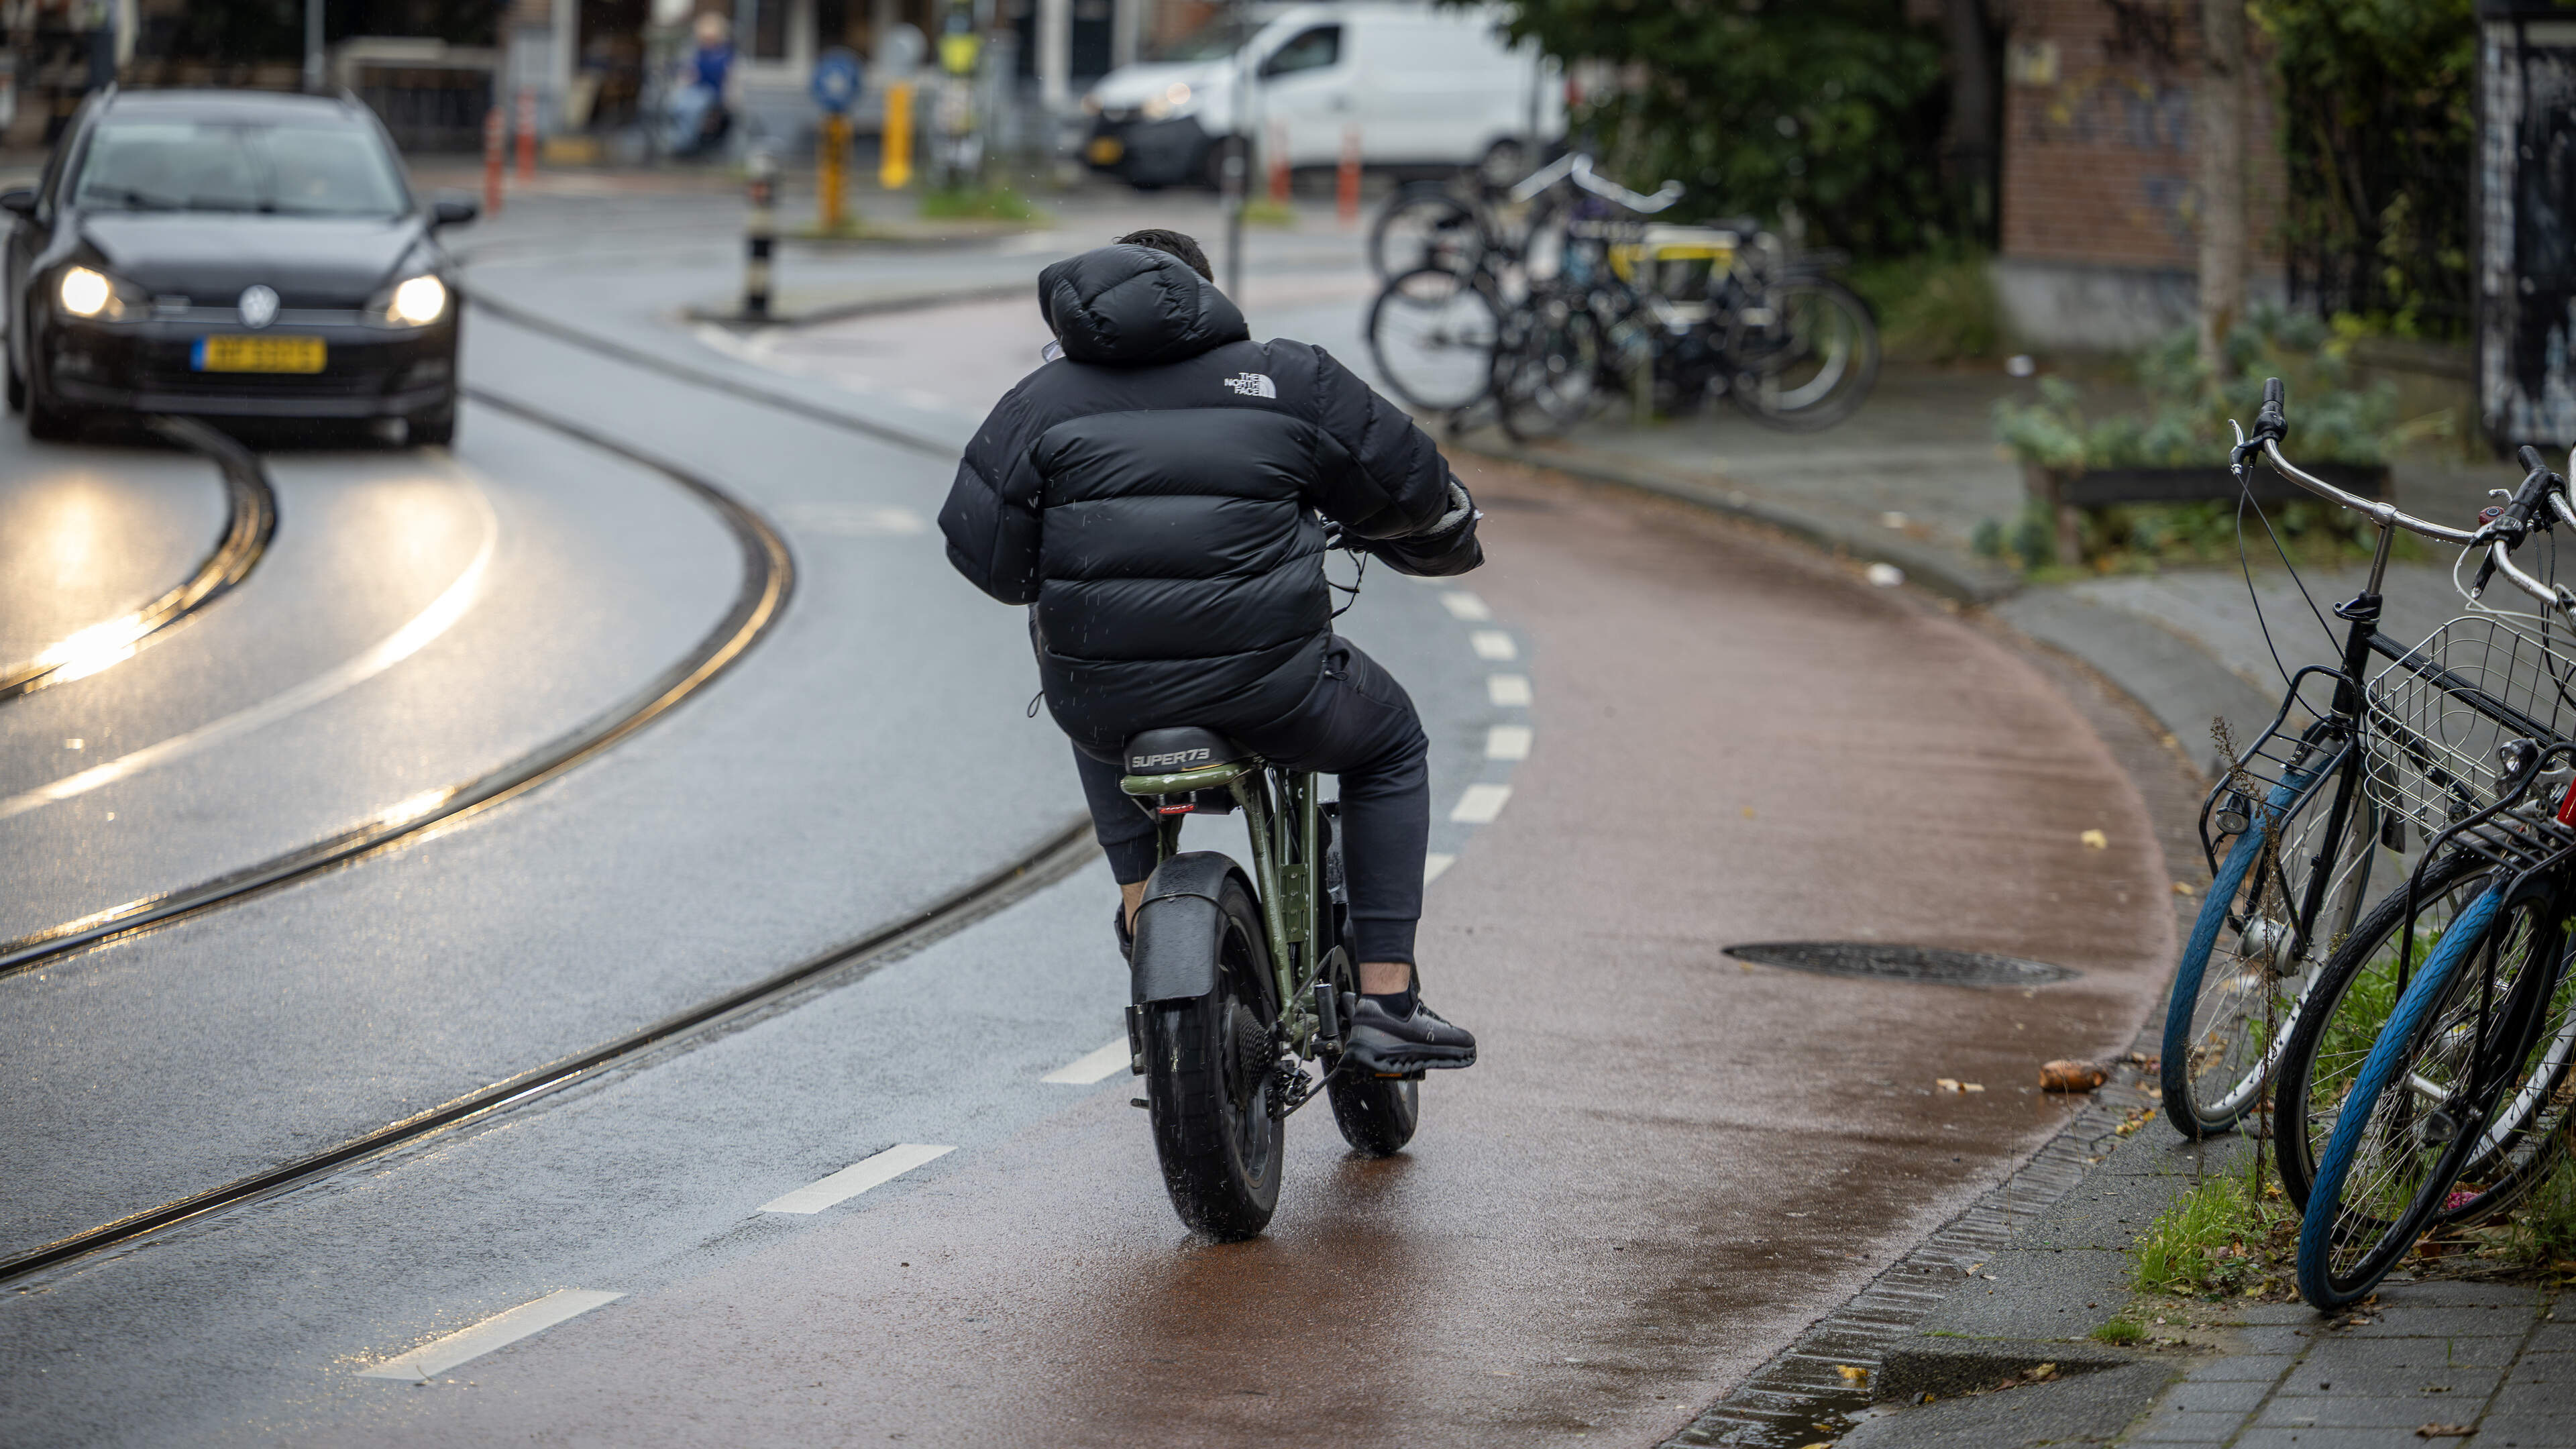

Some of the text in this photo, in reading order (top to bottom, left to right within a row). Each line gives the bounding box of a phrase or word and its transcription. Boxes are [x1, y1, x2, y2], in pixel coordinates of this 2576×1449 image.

[1238, 372, 1259, 382] THE
[1224, 378, 1260, 388] NORTH
[1234, 386, 1259, 396] FACE
[1132, 748, 1210, 767] SUPER73
